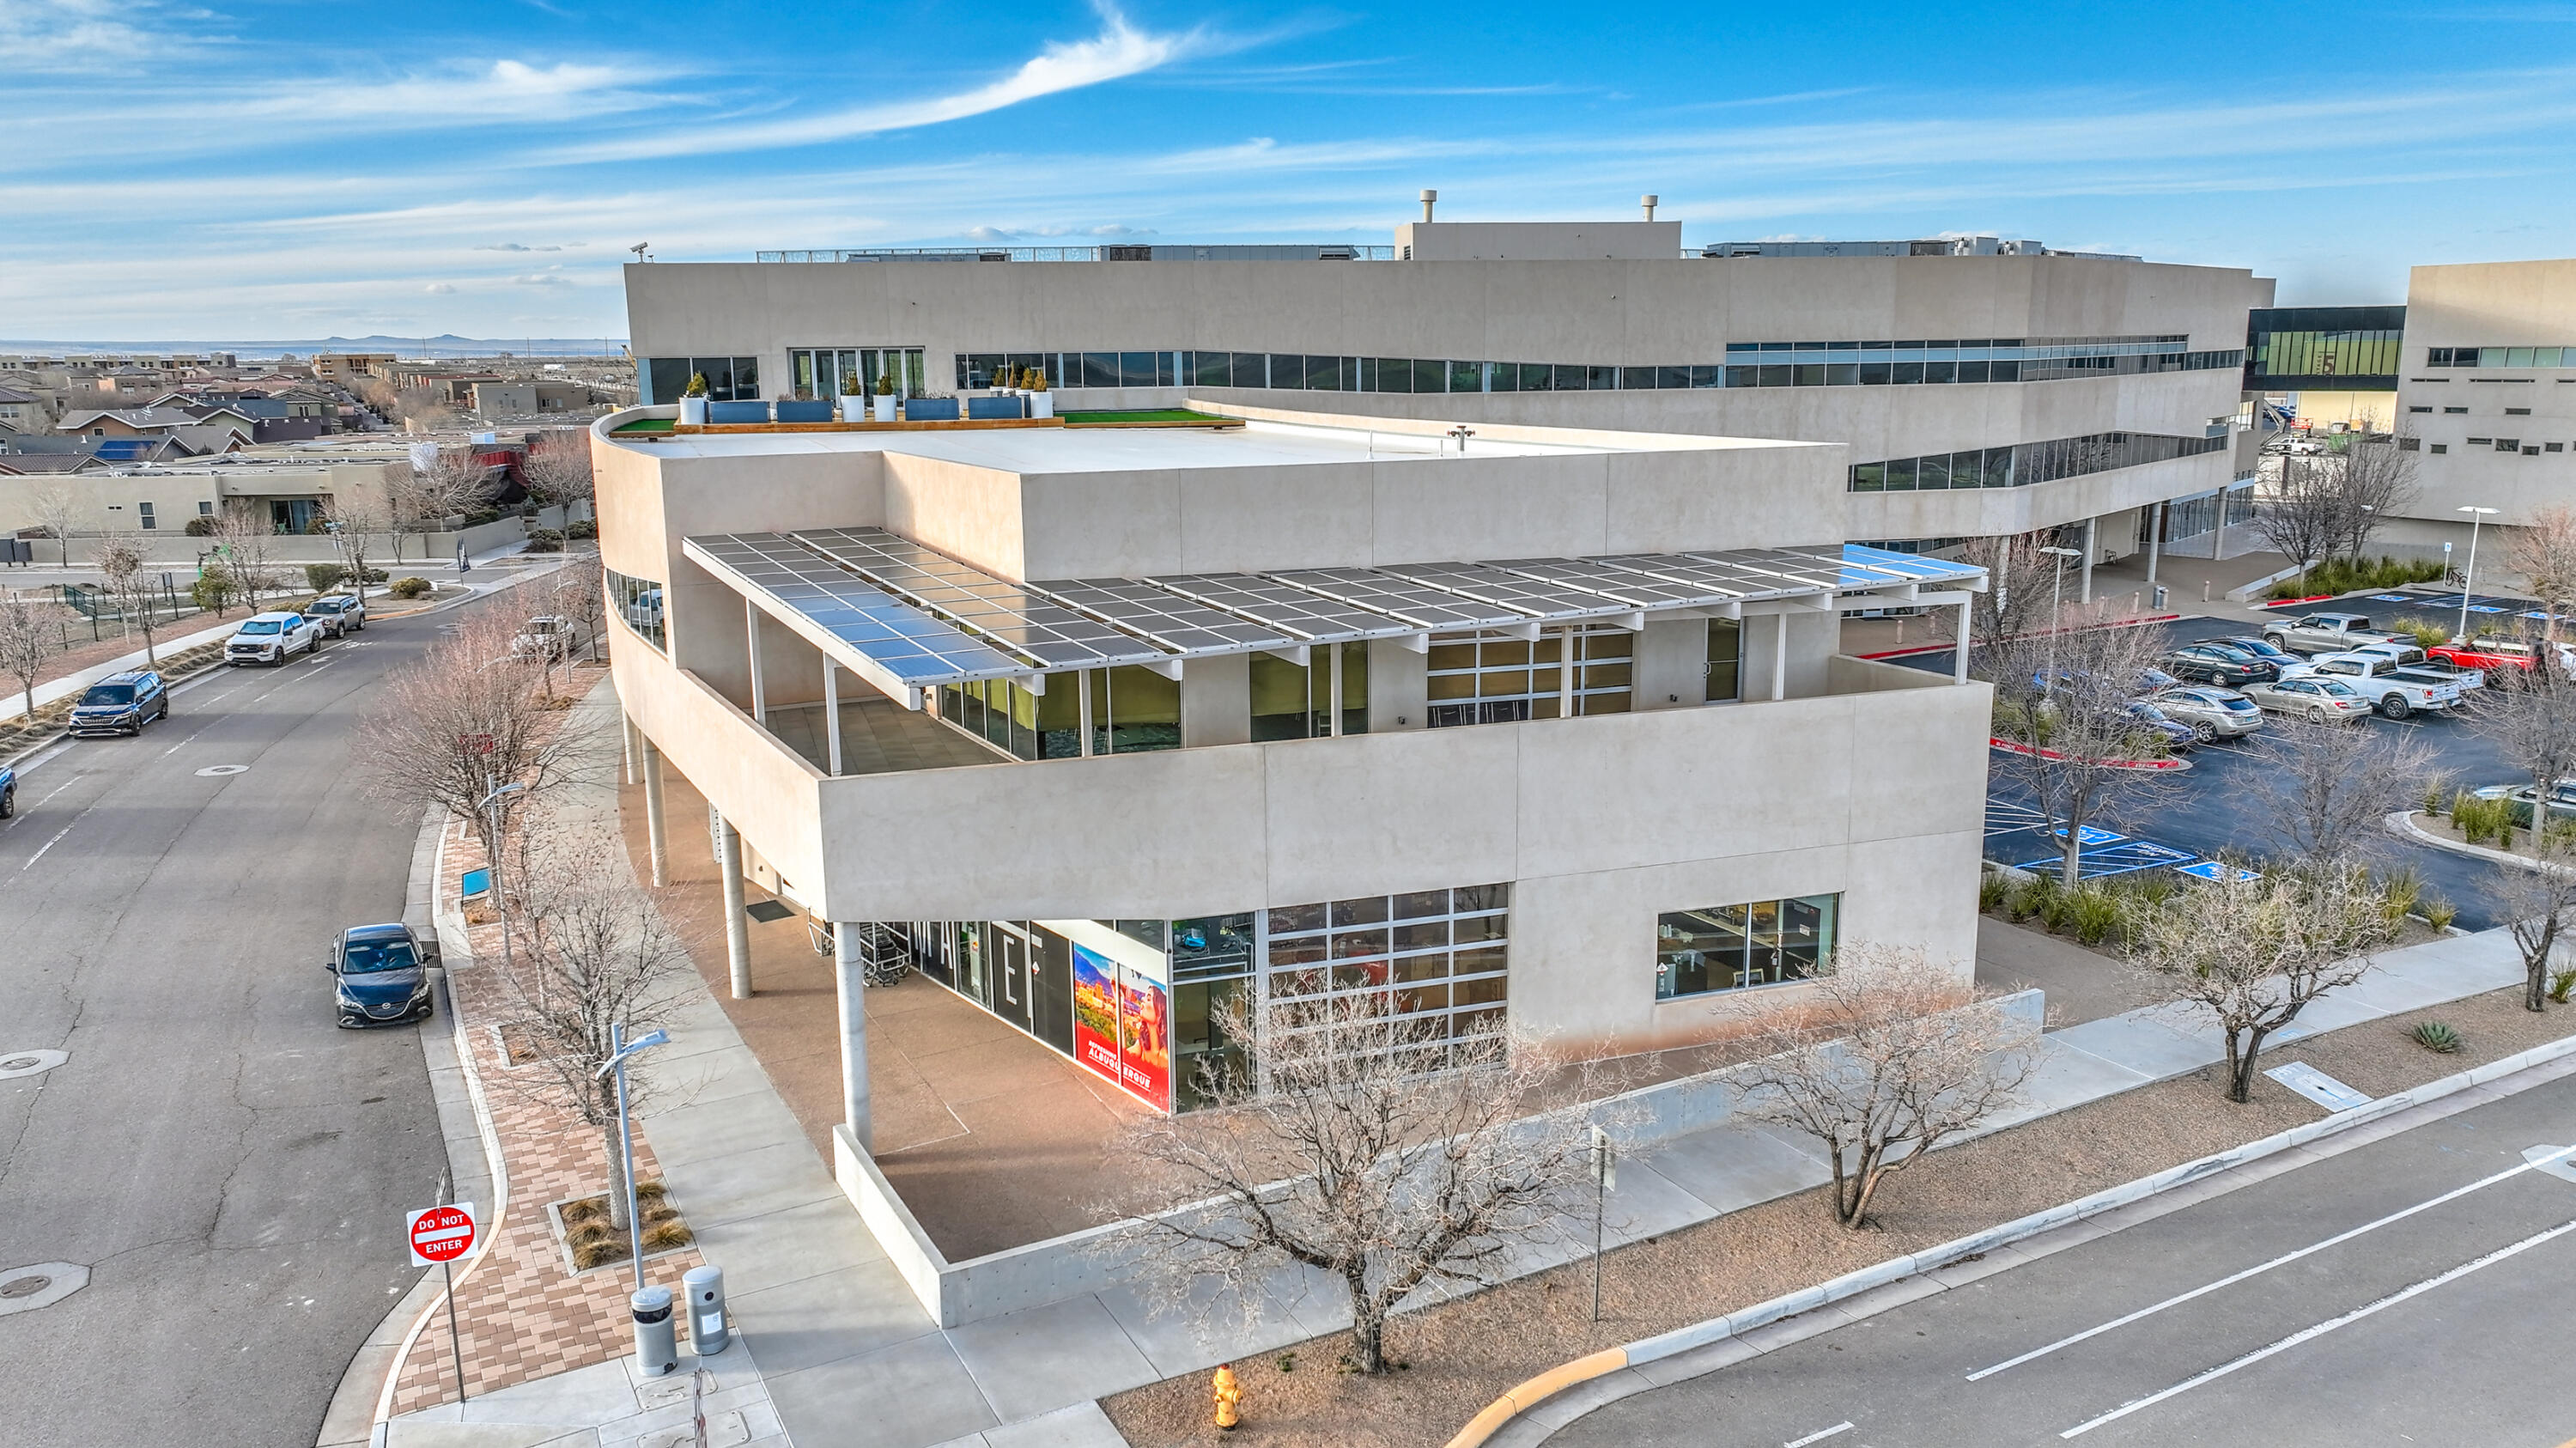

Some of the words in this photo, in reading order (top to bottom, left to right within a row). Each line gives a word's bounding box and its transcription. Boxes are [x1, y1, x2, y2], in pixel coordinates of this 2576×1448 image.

[2324, 355, 2335, 374] 5
[1088, 1047, 1151, 1088] ALBUQUERQUE
[418, 1219, 435, 1231] DO
[440, 1214, 465, 1226] NOT
[425, 1238, 463, 1254] ENTER
